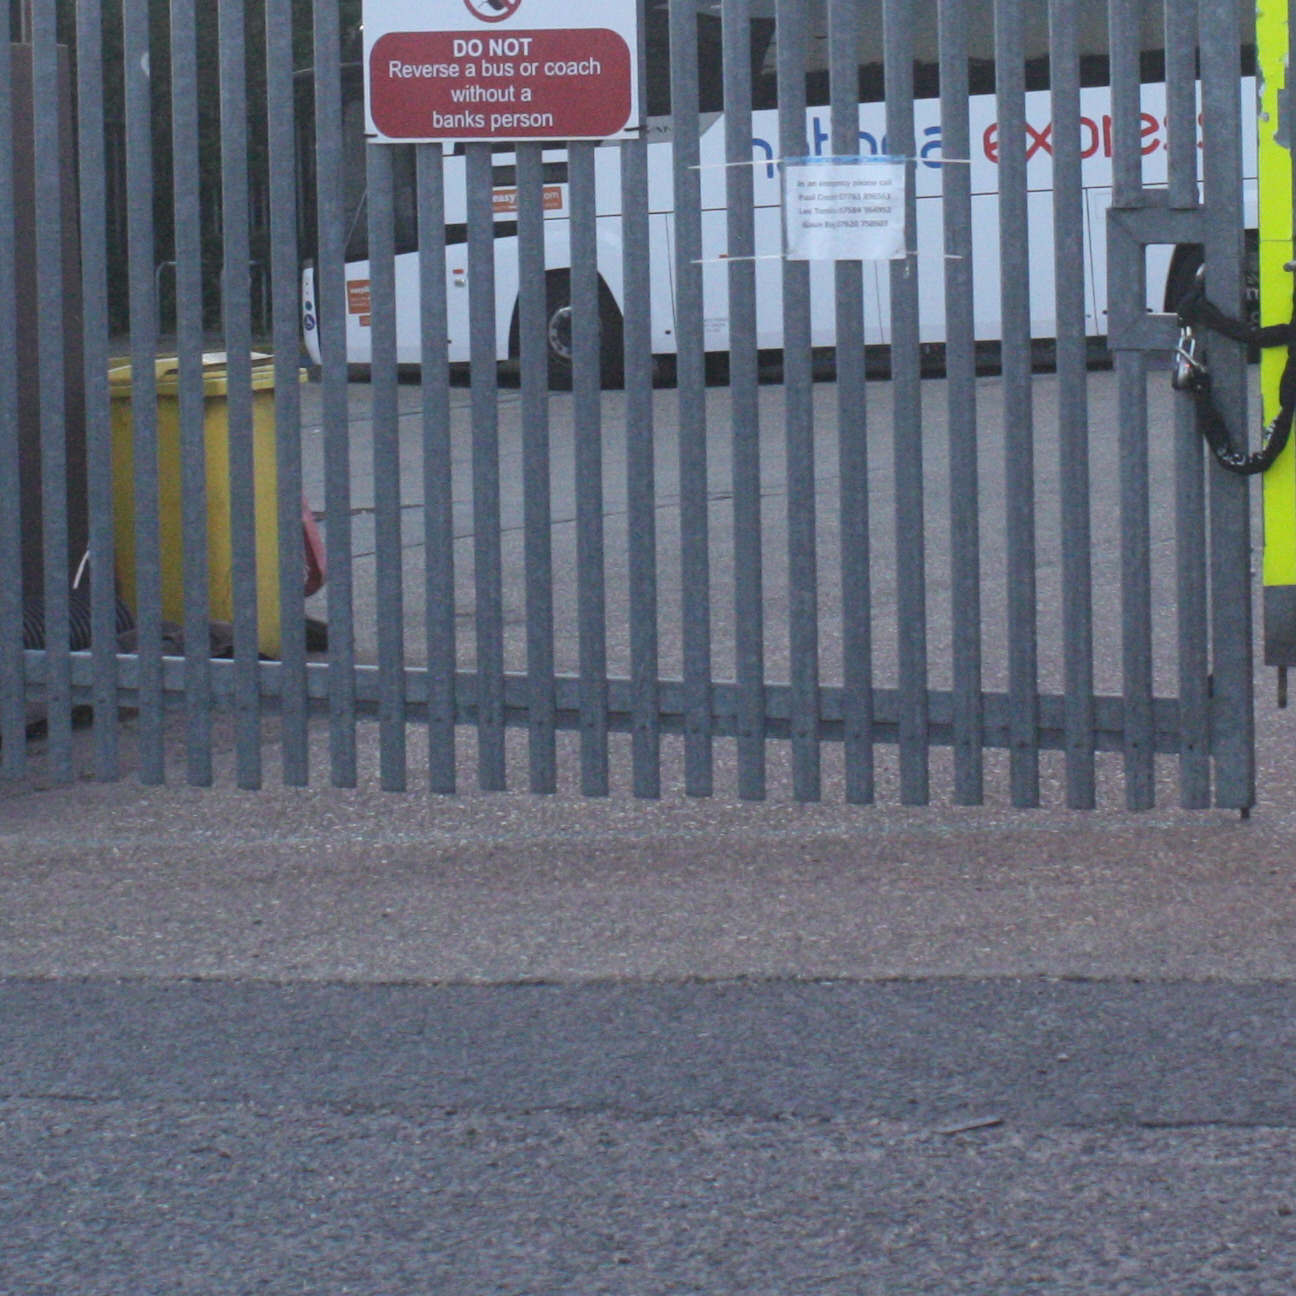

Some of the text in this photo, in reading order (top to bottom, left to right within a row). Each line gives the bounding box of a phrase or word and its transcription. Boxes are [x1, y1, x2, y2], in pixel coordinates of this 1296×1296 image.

[454, 38, 532, 57] DO NOT
[389, 57, 600, 78] Reverse a bus or coach
[451, 86, 531, 102] without a
[433, 112, 553, 132] banks person
